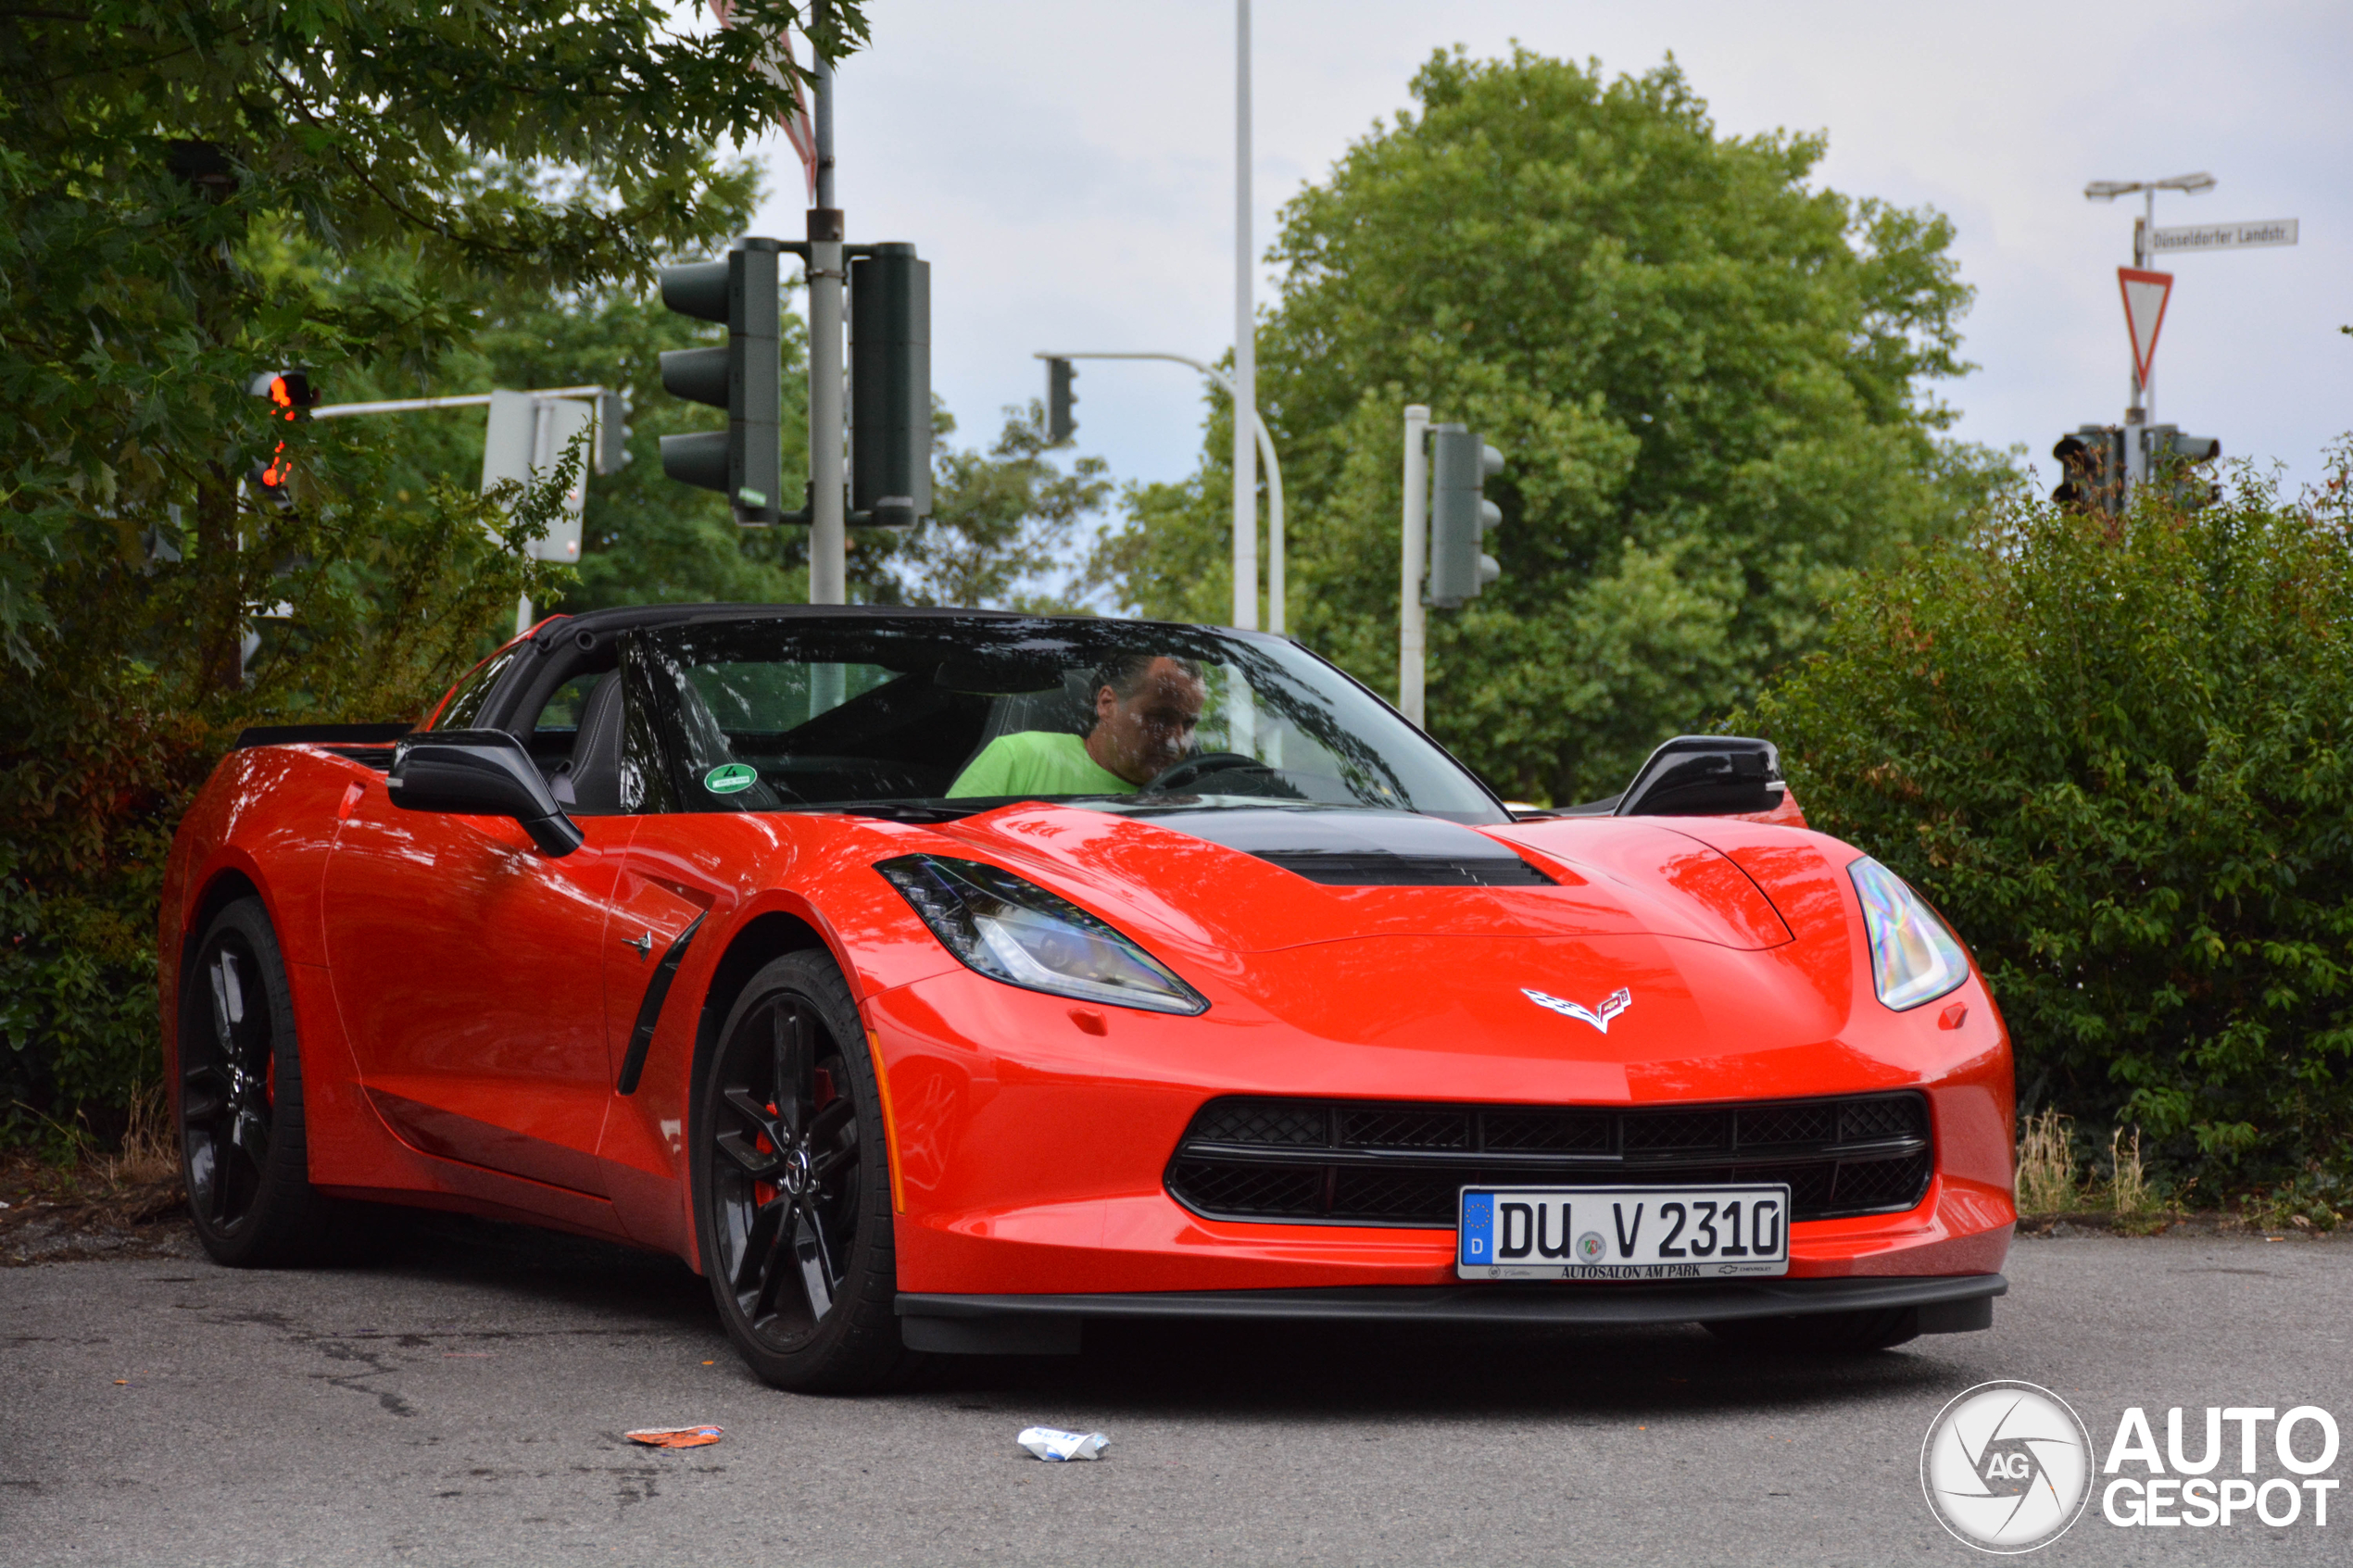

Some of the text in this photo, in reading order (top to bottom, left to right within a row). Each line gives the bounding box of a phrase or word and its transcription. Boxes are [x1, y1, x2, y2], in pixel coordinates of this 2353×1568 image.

[2153, 225, 2288, 249] Düsseldorfer Landstr.
[724, 765, 737, 777] 4
[1499, 1200, 1780, 1259] DU V 2310
[1471, 1238, 1483, 1255] D
[1561, 1265, 1701, 1279] AUTOSALON AM PARK
